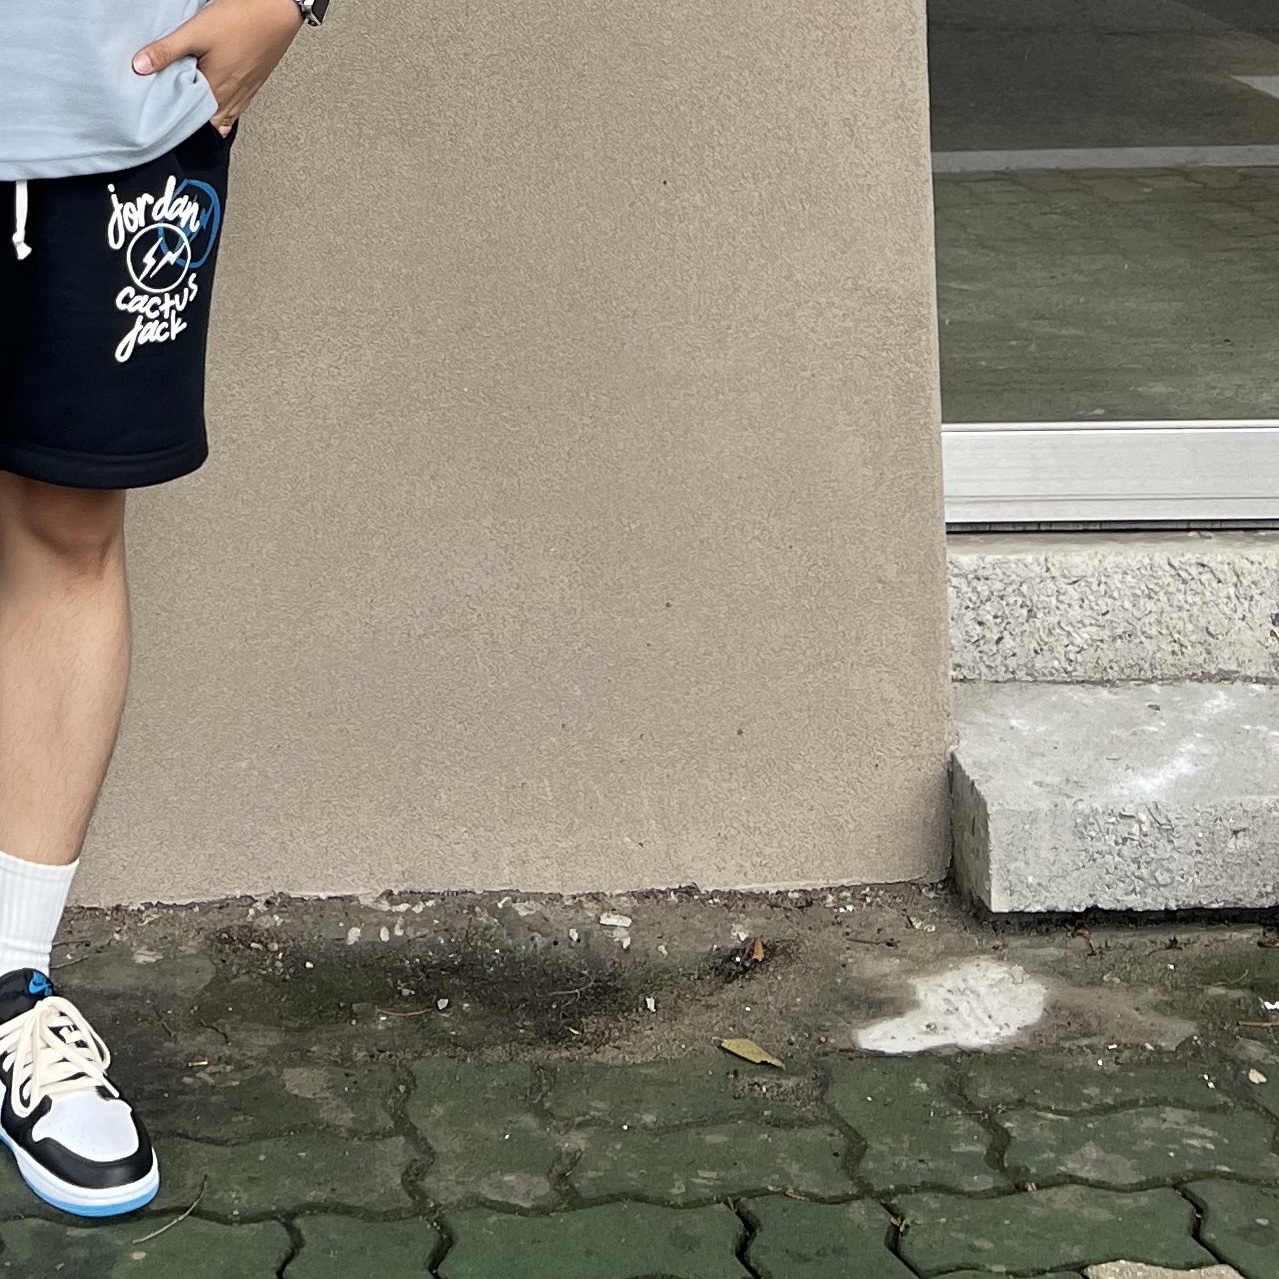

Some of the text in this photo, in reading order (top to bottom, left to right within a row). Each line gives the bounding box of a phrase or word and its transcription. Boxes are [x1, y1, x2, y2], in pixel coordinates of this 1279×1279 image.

[107, 175, 200, 250] jordan
[115, 272, 198, 319] cactus
[114, 309, 188, 363] jack
